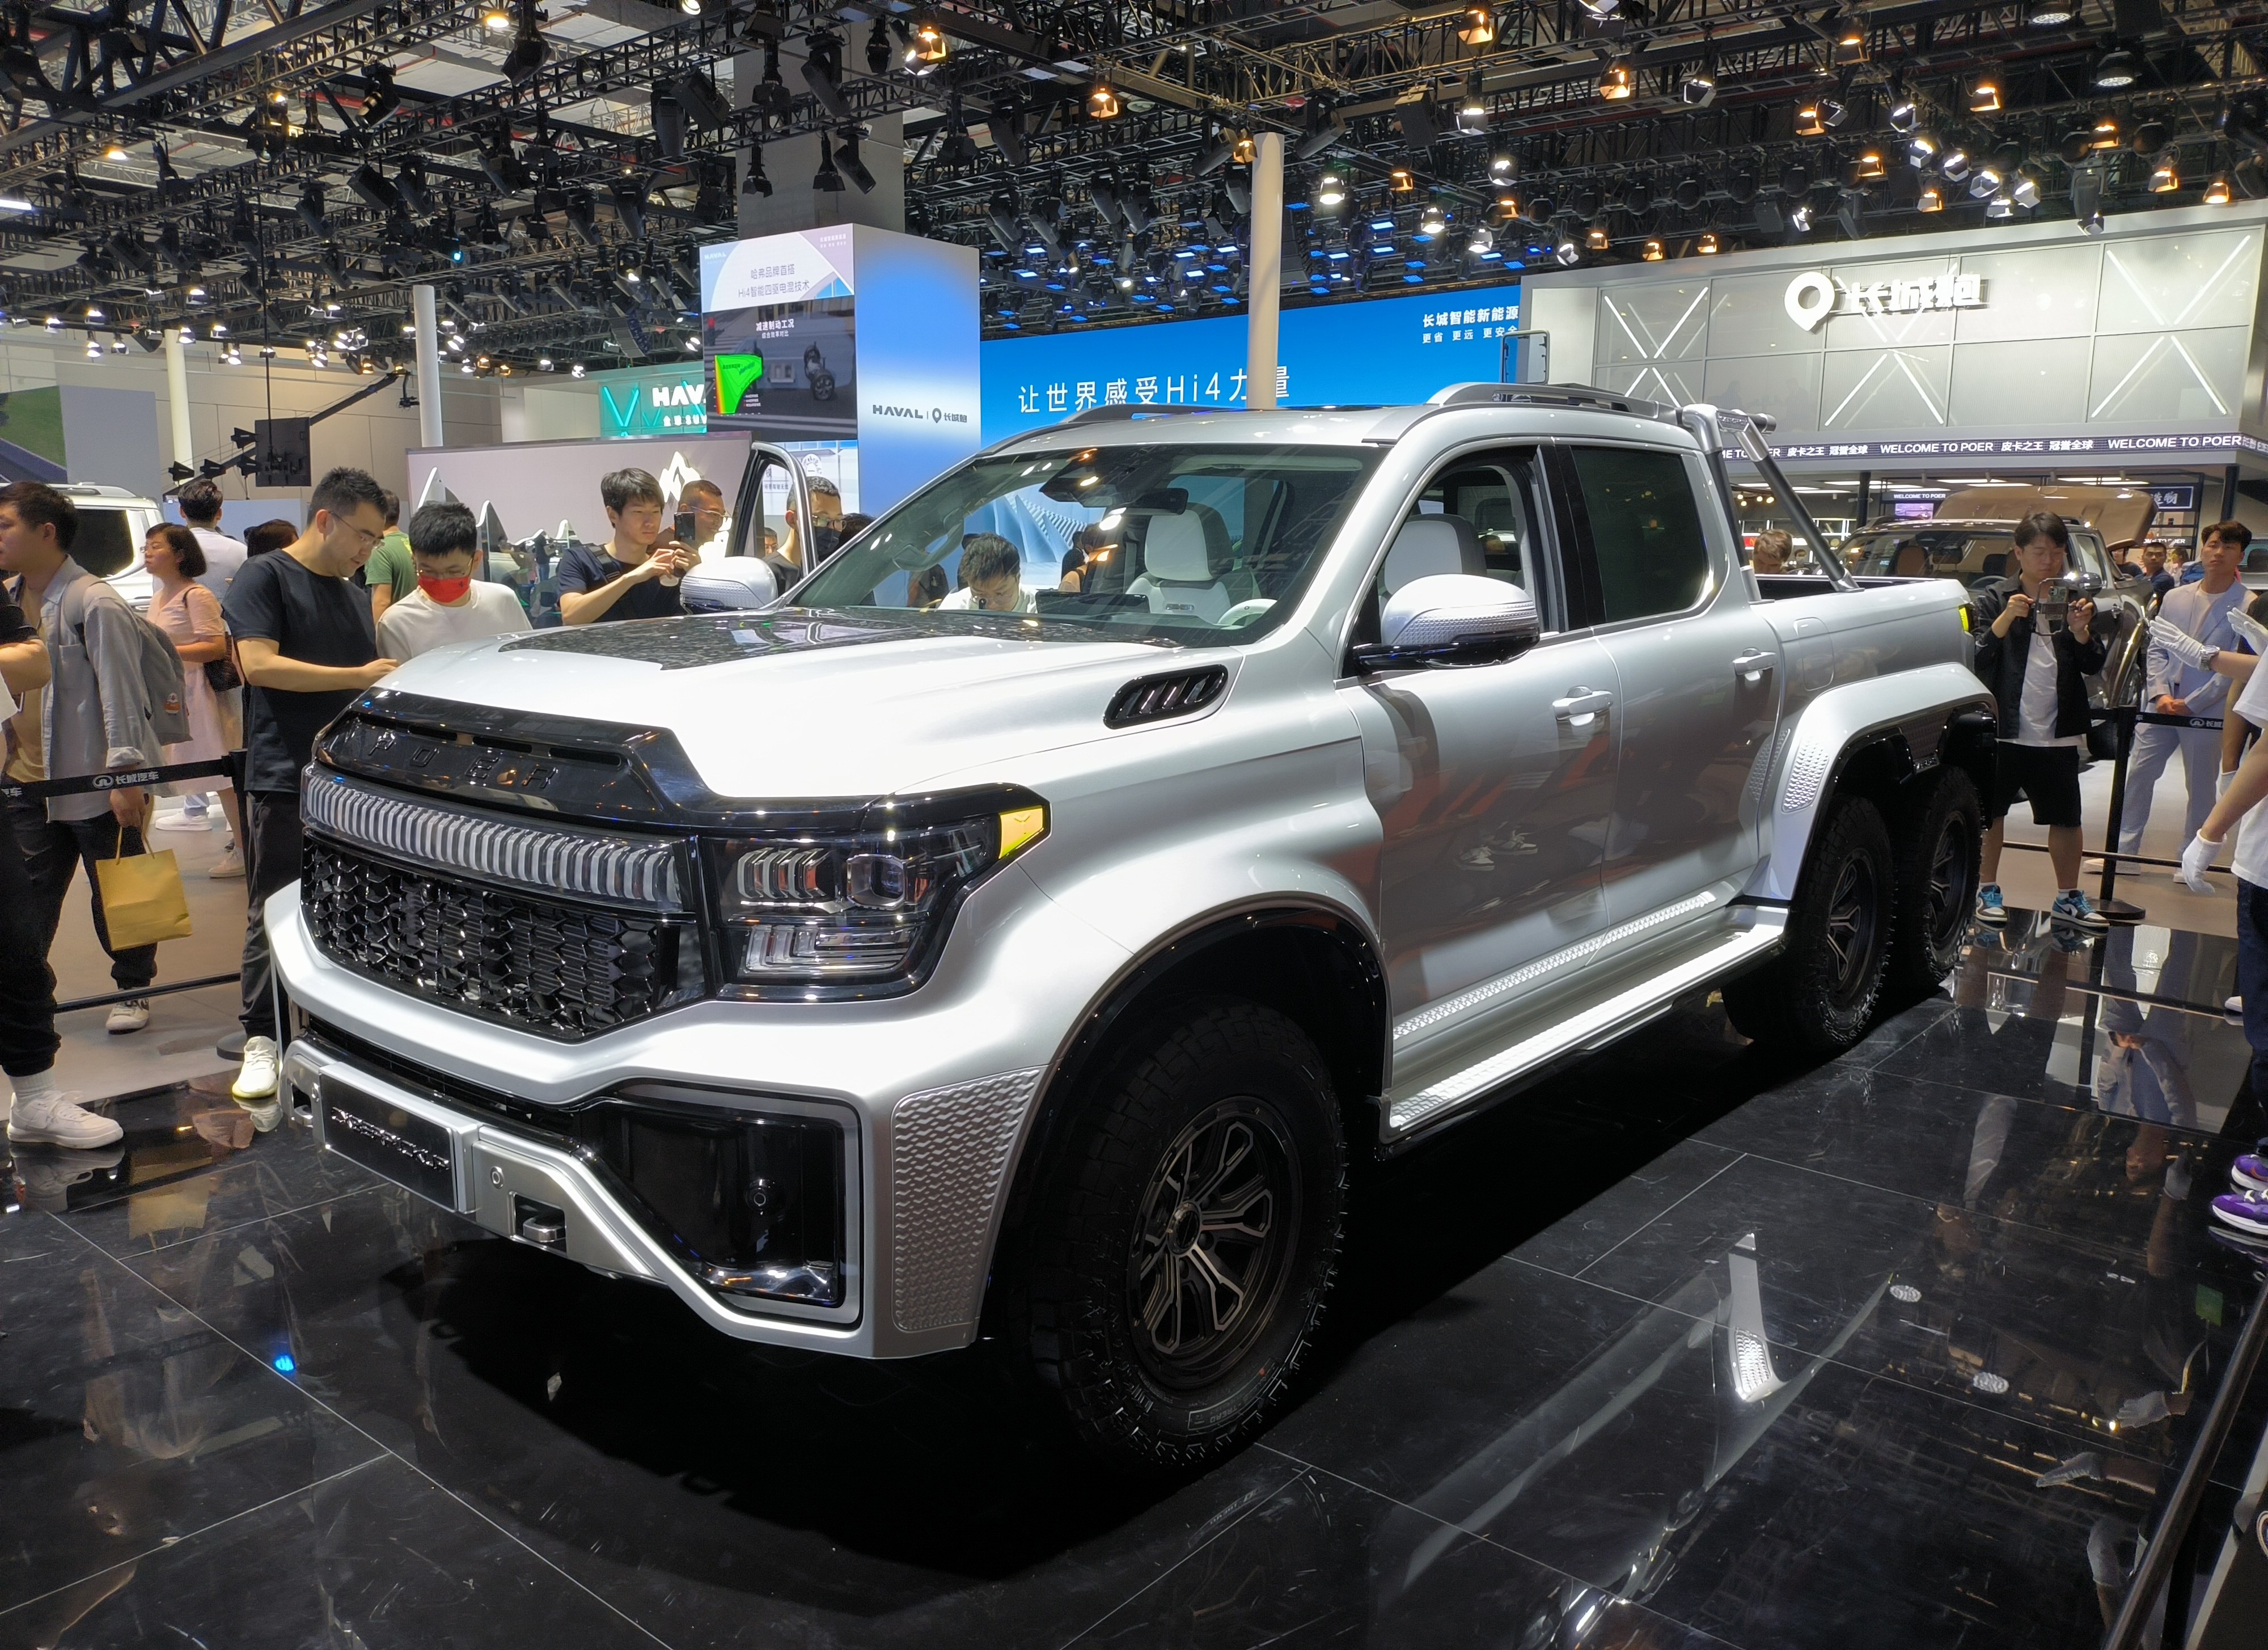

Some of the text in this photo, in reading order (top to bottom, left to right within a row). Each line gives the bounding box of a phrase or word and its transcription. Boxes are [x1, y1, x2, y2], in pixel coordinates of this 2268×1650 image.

[751, 264, 795, 280] 哈弗品牌首搭
[738, 280, 810, 298] Hi4智能四驱电混技术
[1423, 305, 1520, 328] 长城智能新能源
[1422, 332, 1444, 344] 更省
[1452, 329, 1474, 341] 更远
[653, 384, 706, 407] HAV
[873, 404, 924, 419] HAVAL
[1787, 446, 1825, 457] 皮卡之王
[1880, 443, 1939, 454] WELCOME
[1942, 443, 1958, 452] TO
[1960, 442, 1994, 452] POER
[2001, 441, 2043, 452] 皮卡之王
[2049, 439, 2094, 451] 冠誉全球
[2108, 437, 2177, 449] WELCOME
[2180, 437, 2199, 447] TO
[2202, 435, 2242, 446] POER
[115, 771, 159, 785] 长城汽车
